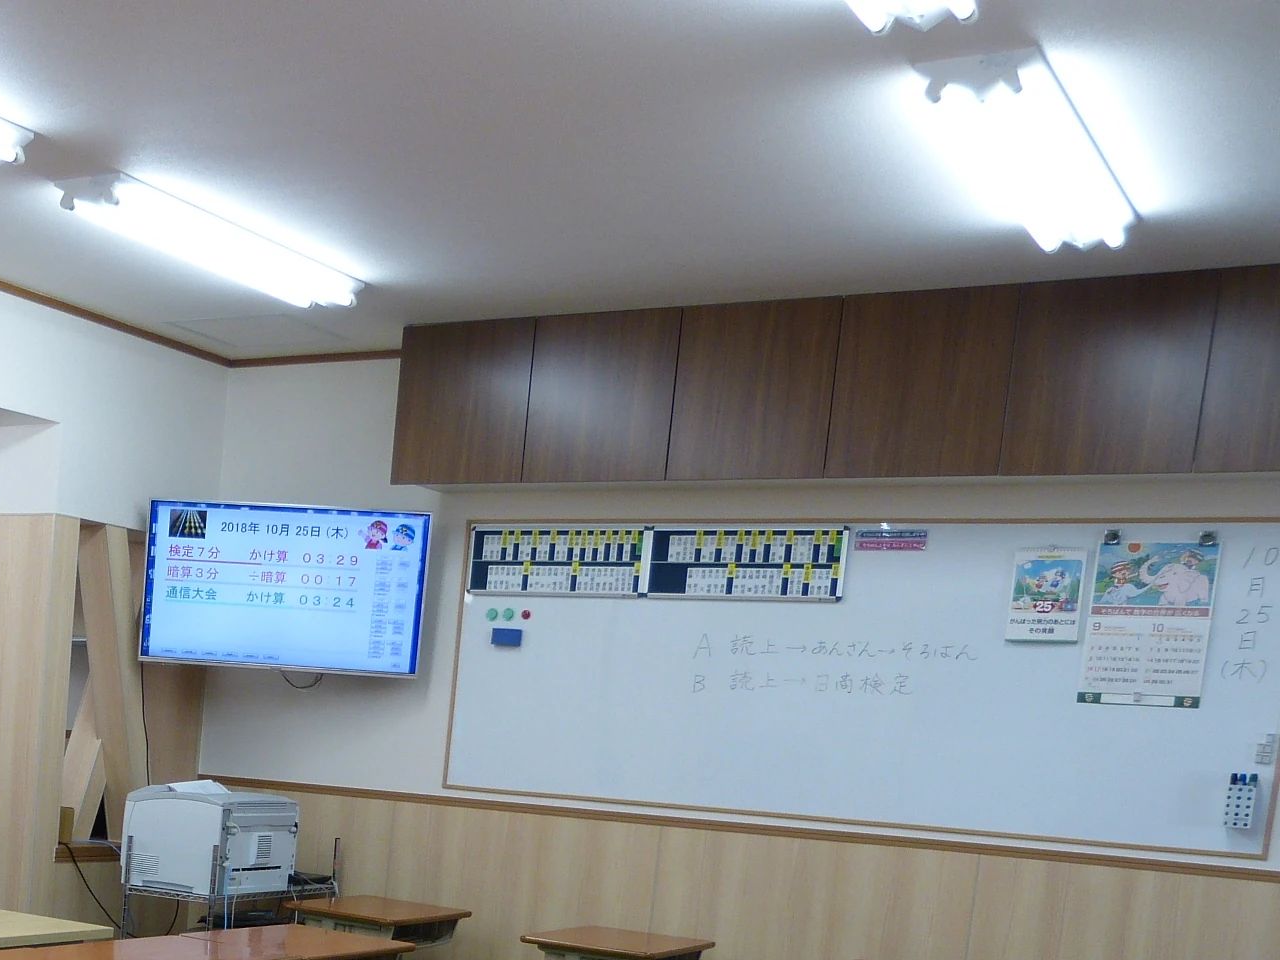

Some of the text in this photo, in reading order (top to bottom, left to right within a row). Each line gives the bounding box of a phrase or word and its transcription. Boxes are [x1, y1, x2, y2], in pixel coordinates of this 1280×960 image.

[220, 521, 260, 535] 2018年
[266, 523, 290, 536] 10月
[295, 525, 321, 538] 25日
[168, 543, 220, 559] 検定7分
[249, 548, 288, 564] かけ算
[167, 564, 219, 580] 暗算3分
[165, 585, 217, 600] 通信大会
[246, 590, 286, 605] かけ算
[1035, 600, 1053, 612] 25
[692, 633, 711, 658] A
[693, 674, 706, 693] B
